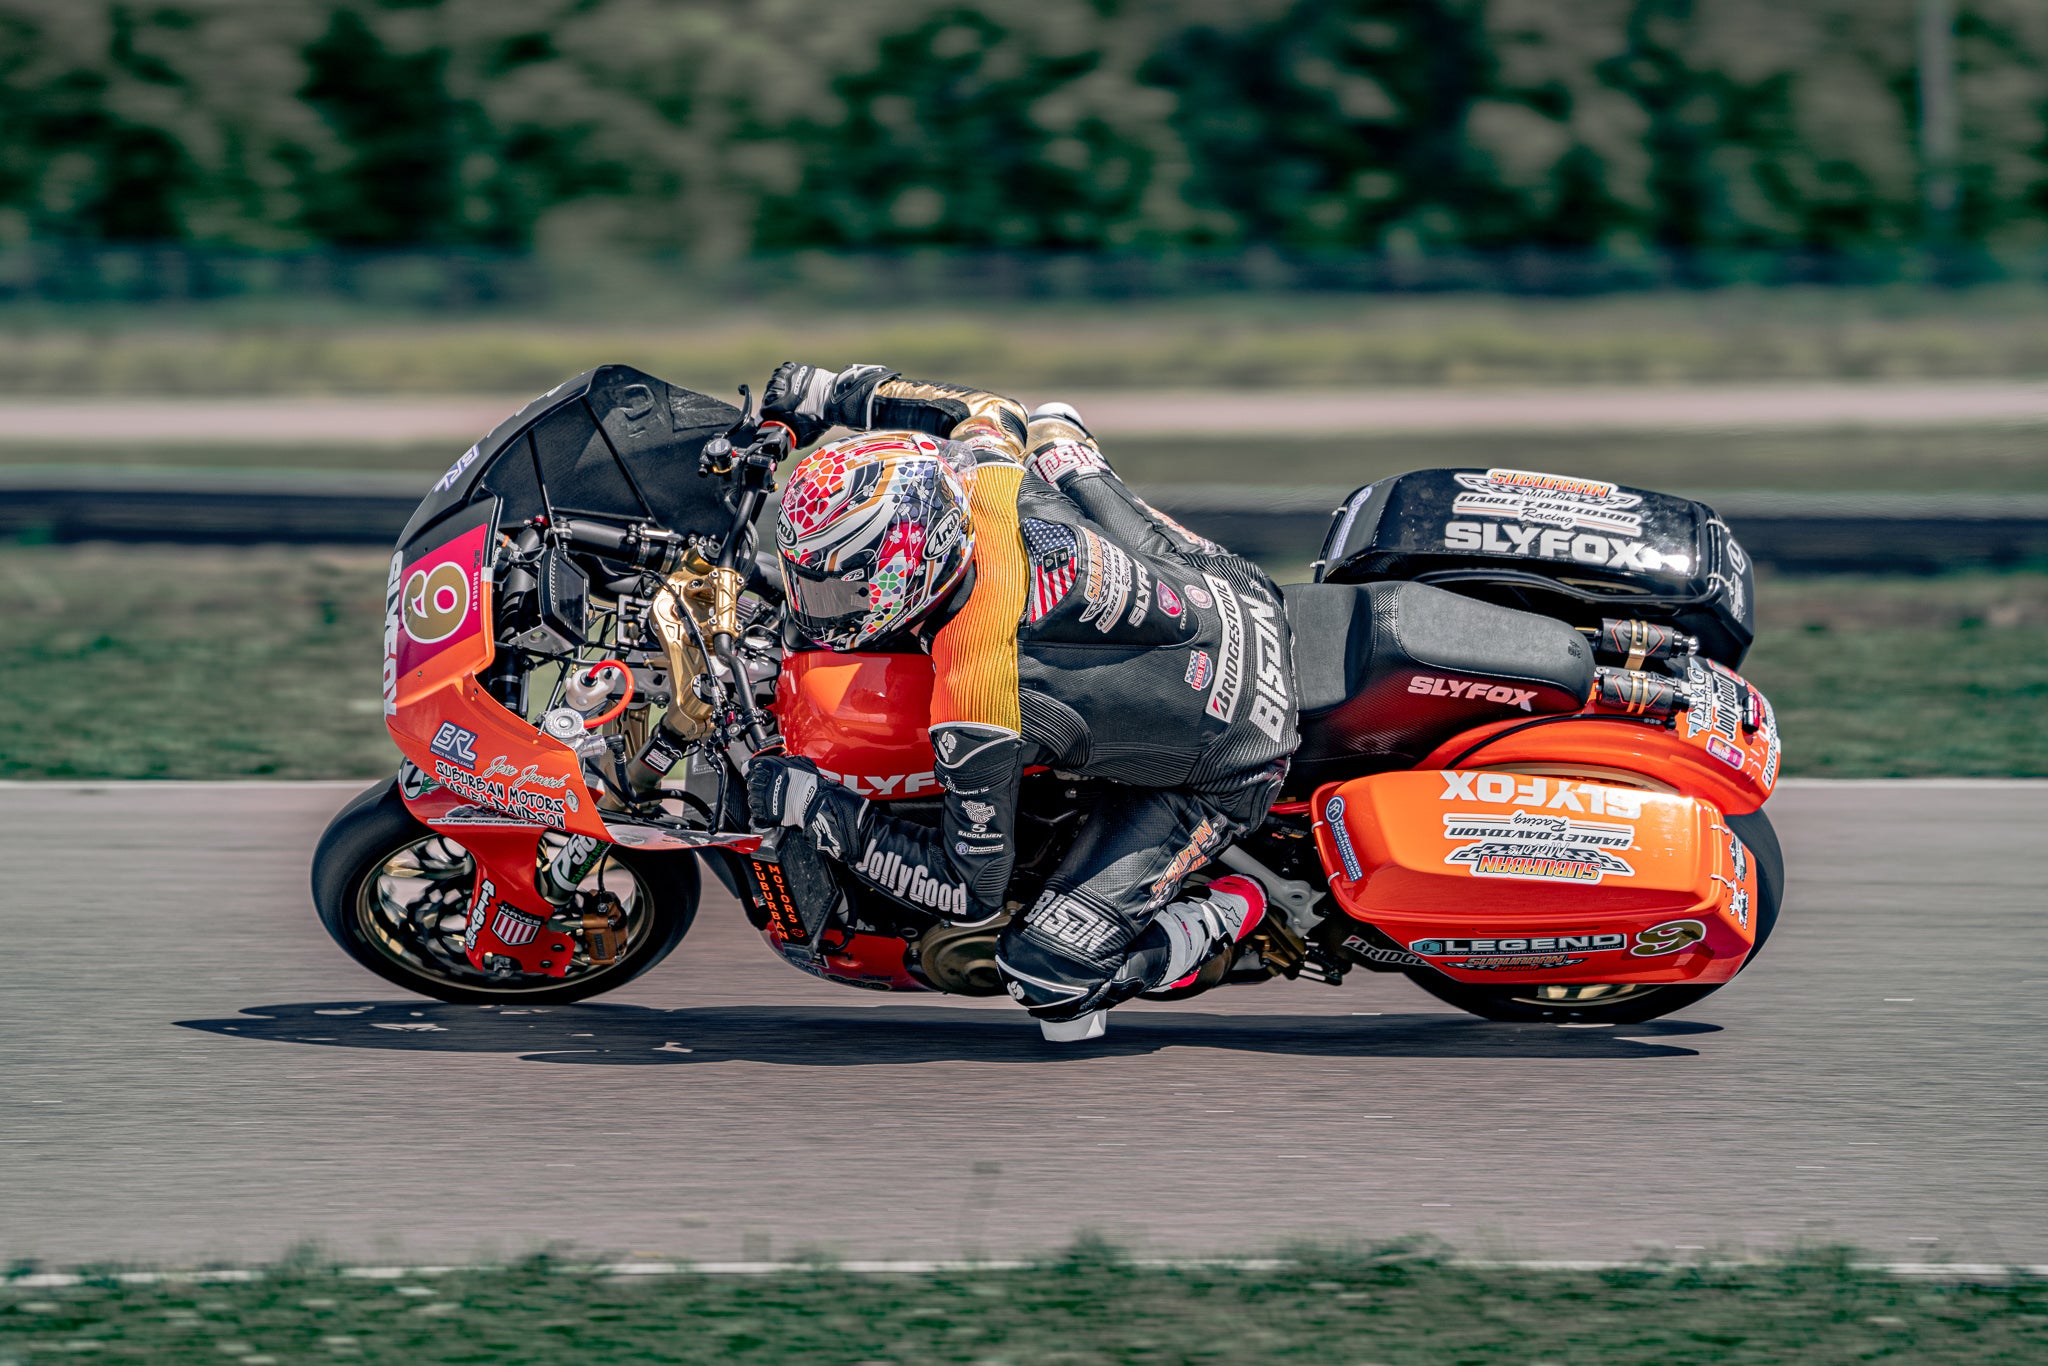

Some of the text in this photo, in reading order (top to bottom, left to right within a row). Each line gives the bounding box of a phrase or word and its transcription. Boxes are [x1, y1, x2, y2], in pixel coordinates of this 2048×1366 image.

[1490, 472, 1608, 498] SUBURBAN
[1458, 495, 1637, 524] HARLEY-DAVIDSON
[1521, 508, 1574, 525] Racing
[930, 513, 960, 547] Arai
[1445, 522, 1647, 571] SLYFOX
[472, 602, 478, 611] GP
[1212, 579, 1240, 718] BRIDGESTONE
[1193, 653, 1207, 688] FRED FOX
[1239, 593, 1289, 742] BISON
[1408, 676, 1537, 711] SLYFOX
[432, 722, 477, 761] BRL
[445, 753, 459, 763] RACING
[459, 758, 474, 769] LEAGUE
[483, 756, 518, 778] Jesse
[436, 761, 565, 813] SUBURBAN MOTORS
[817, 767, 945, 795] LYF
[1440, 771, 1641, 818] SLYFOX
[1449, 827, 1629, 846] HARLEY-DAVIDSON
[1513, 813, 1566, 831] Racing
[1334, 822, 1358, 879] Machine.com
[1339, 819, 1362, 878] Performance
[1508, 842, 1570, 858] Motors
[1479, 856, 1600, 880] SUBURBAN
[753, 862, 789, 940] SUBURBAN
[768, 864, 798, 924] MOTORS
[1024, 890, 1121, 951] BISON
[1446, 934, 1623, 952] LEGEND
[1631, 919, 1707, 957] 9
[1469, 954, 1565, 967] SUBURBAN
